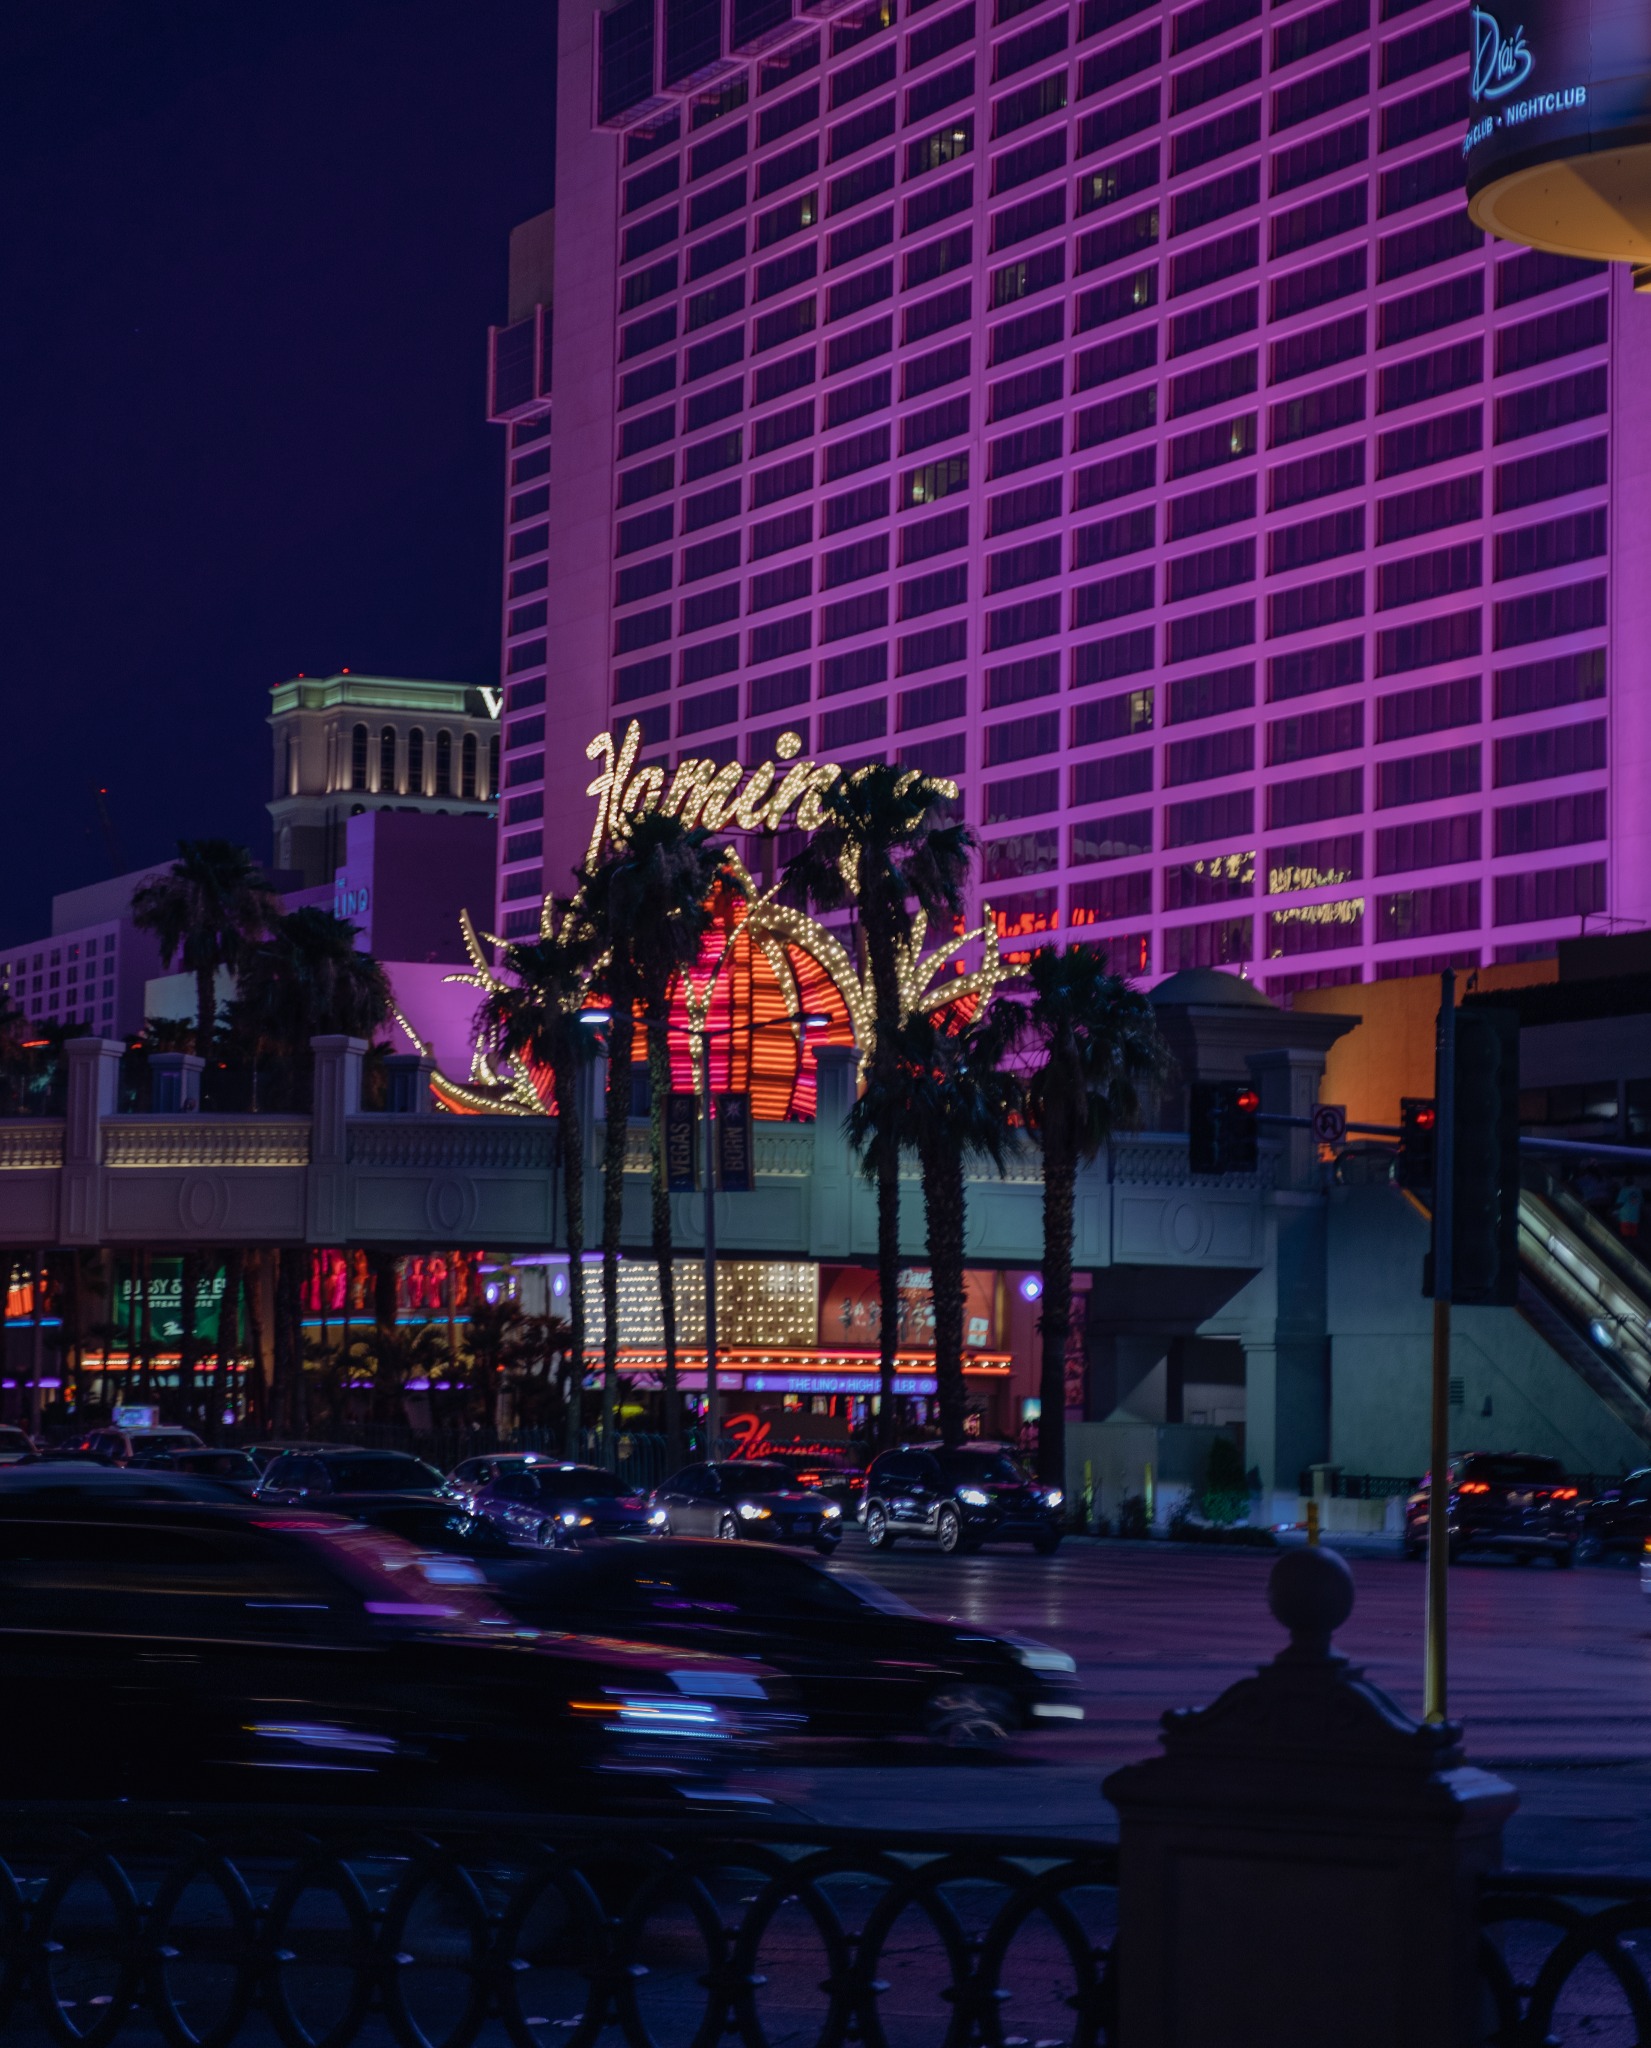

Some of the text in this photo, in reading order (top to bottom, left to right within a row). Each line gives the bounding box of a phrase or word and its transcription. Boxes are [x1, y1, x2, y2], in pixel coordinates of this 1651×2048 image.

[1471, 4, 1534, 103] Drai's
[1506, 86, 1586, 127] NIGHTCLUB
[334, 888, 368, 919] LINQ
[669, 1123, 691, 1176] VEGAS
[723, 1127, 745, 1172] BORN
[148, 1300, 214, 1309] STEAKUSE
[788, 1378, 811, 1392] THE
[812, 1378, 838, 1393] LINQ
[874, 1378, 916, 1393] RLER
